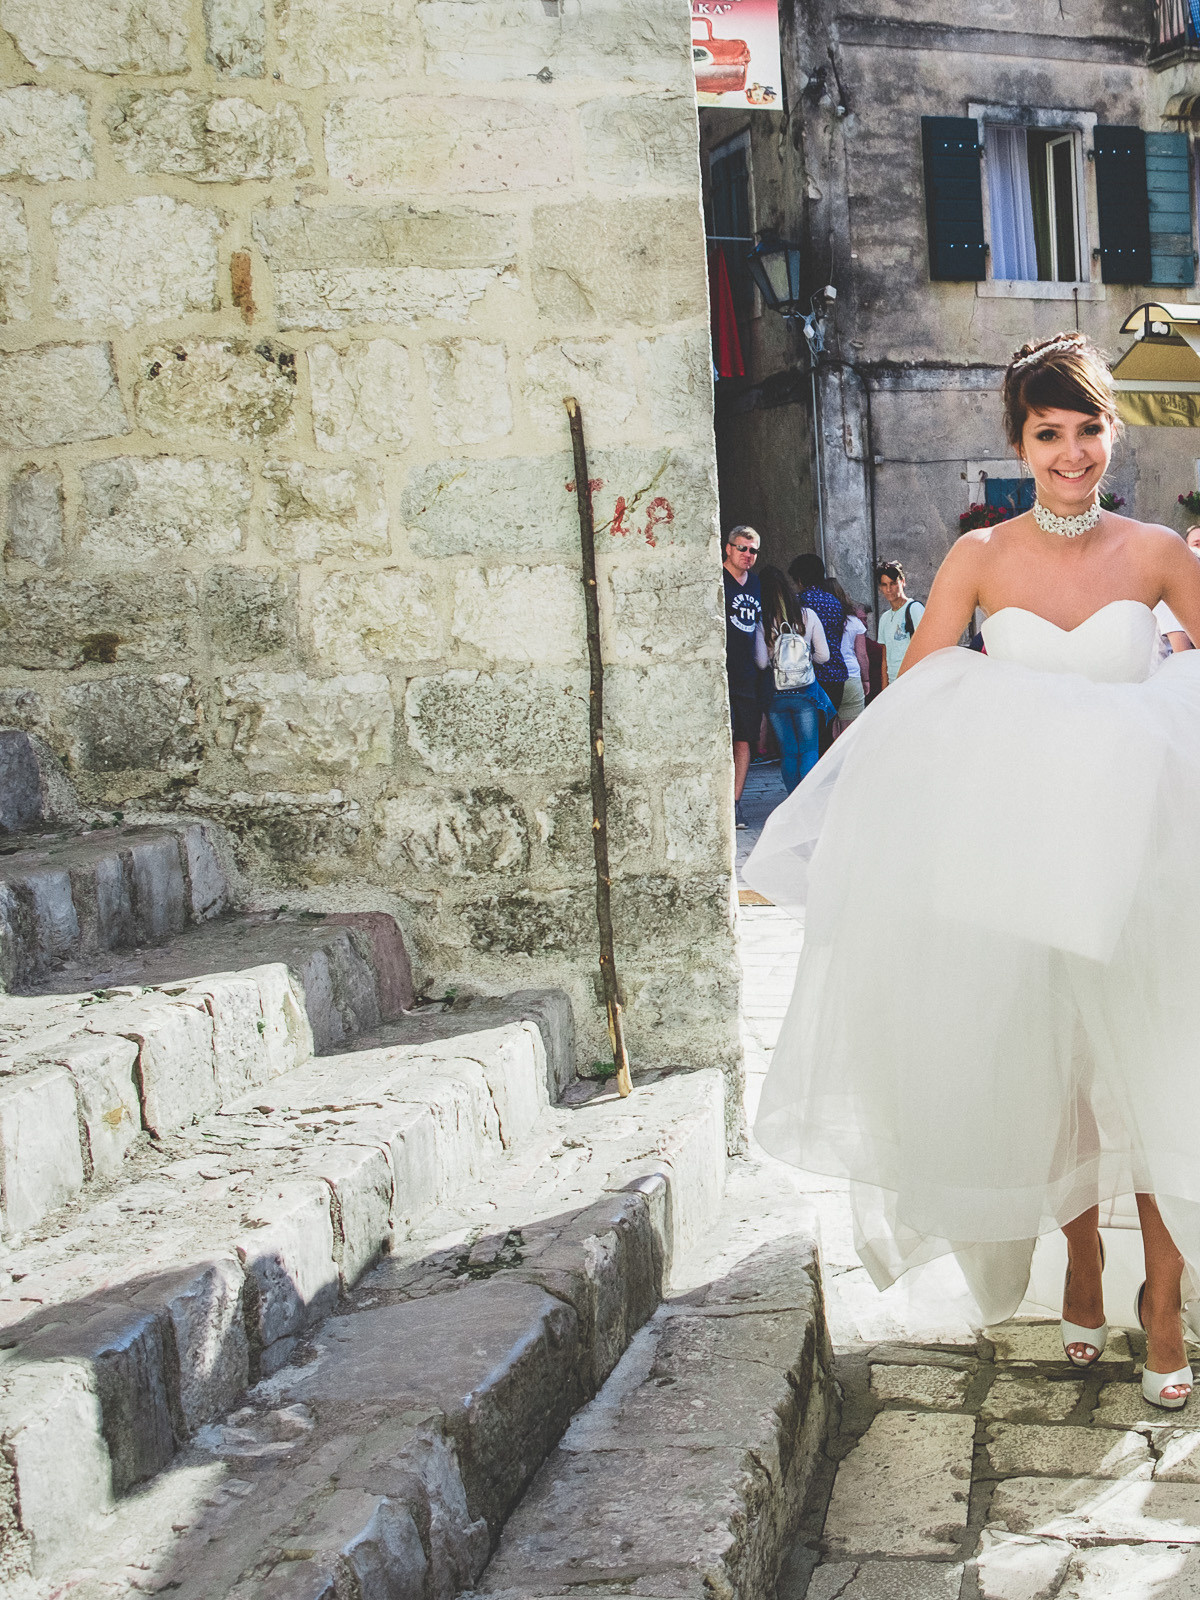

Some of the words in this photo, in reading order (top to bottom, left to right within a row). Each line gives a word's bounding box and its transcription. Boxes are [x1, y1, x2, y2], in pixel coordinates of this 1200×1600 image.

[731, 593, 745, 609] NEW
[744, 593, 762, 612] YORK
[738, 607, 756, 620] TH
